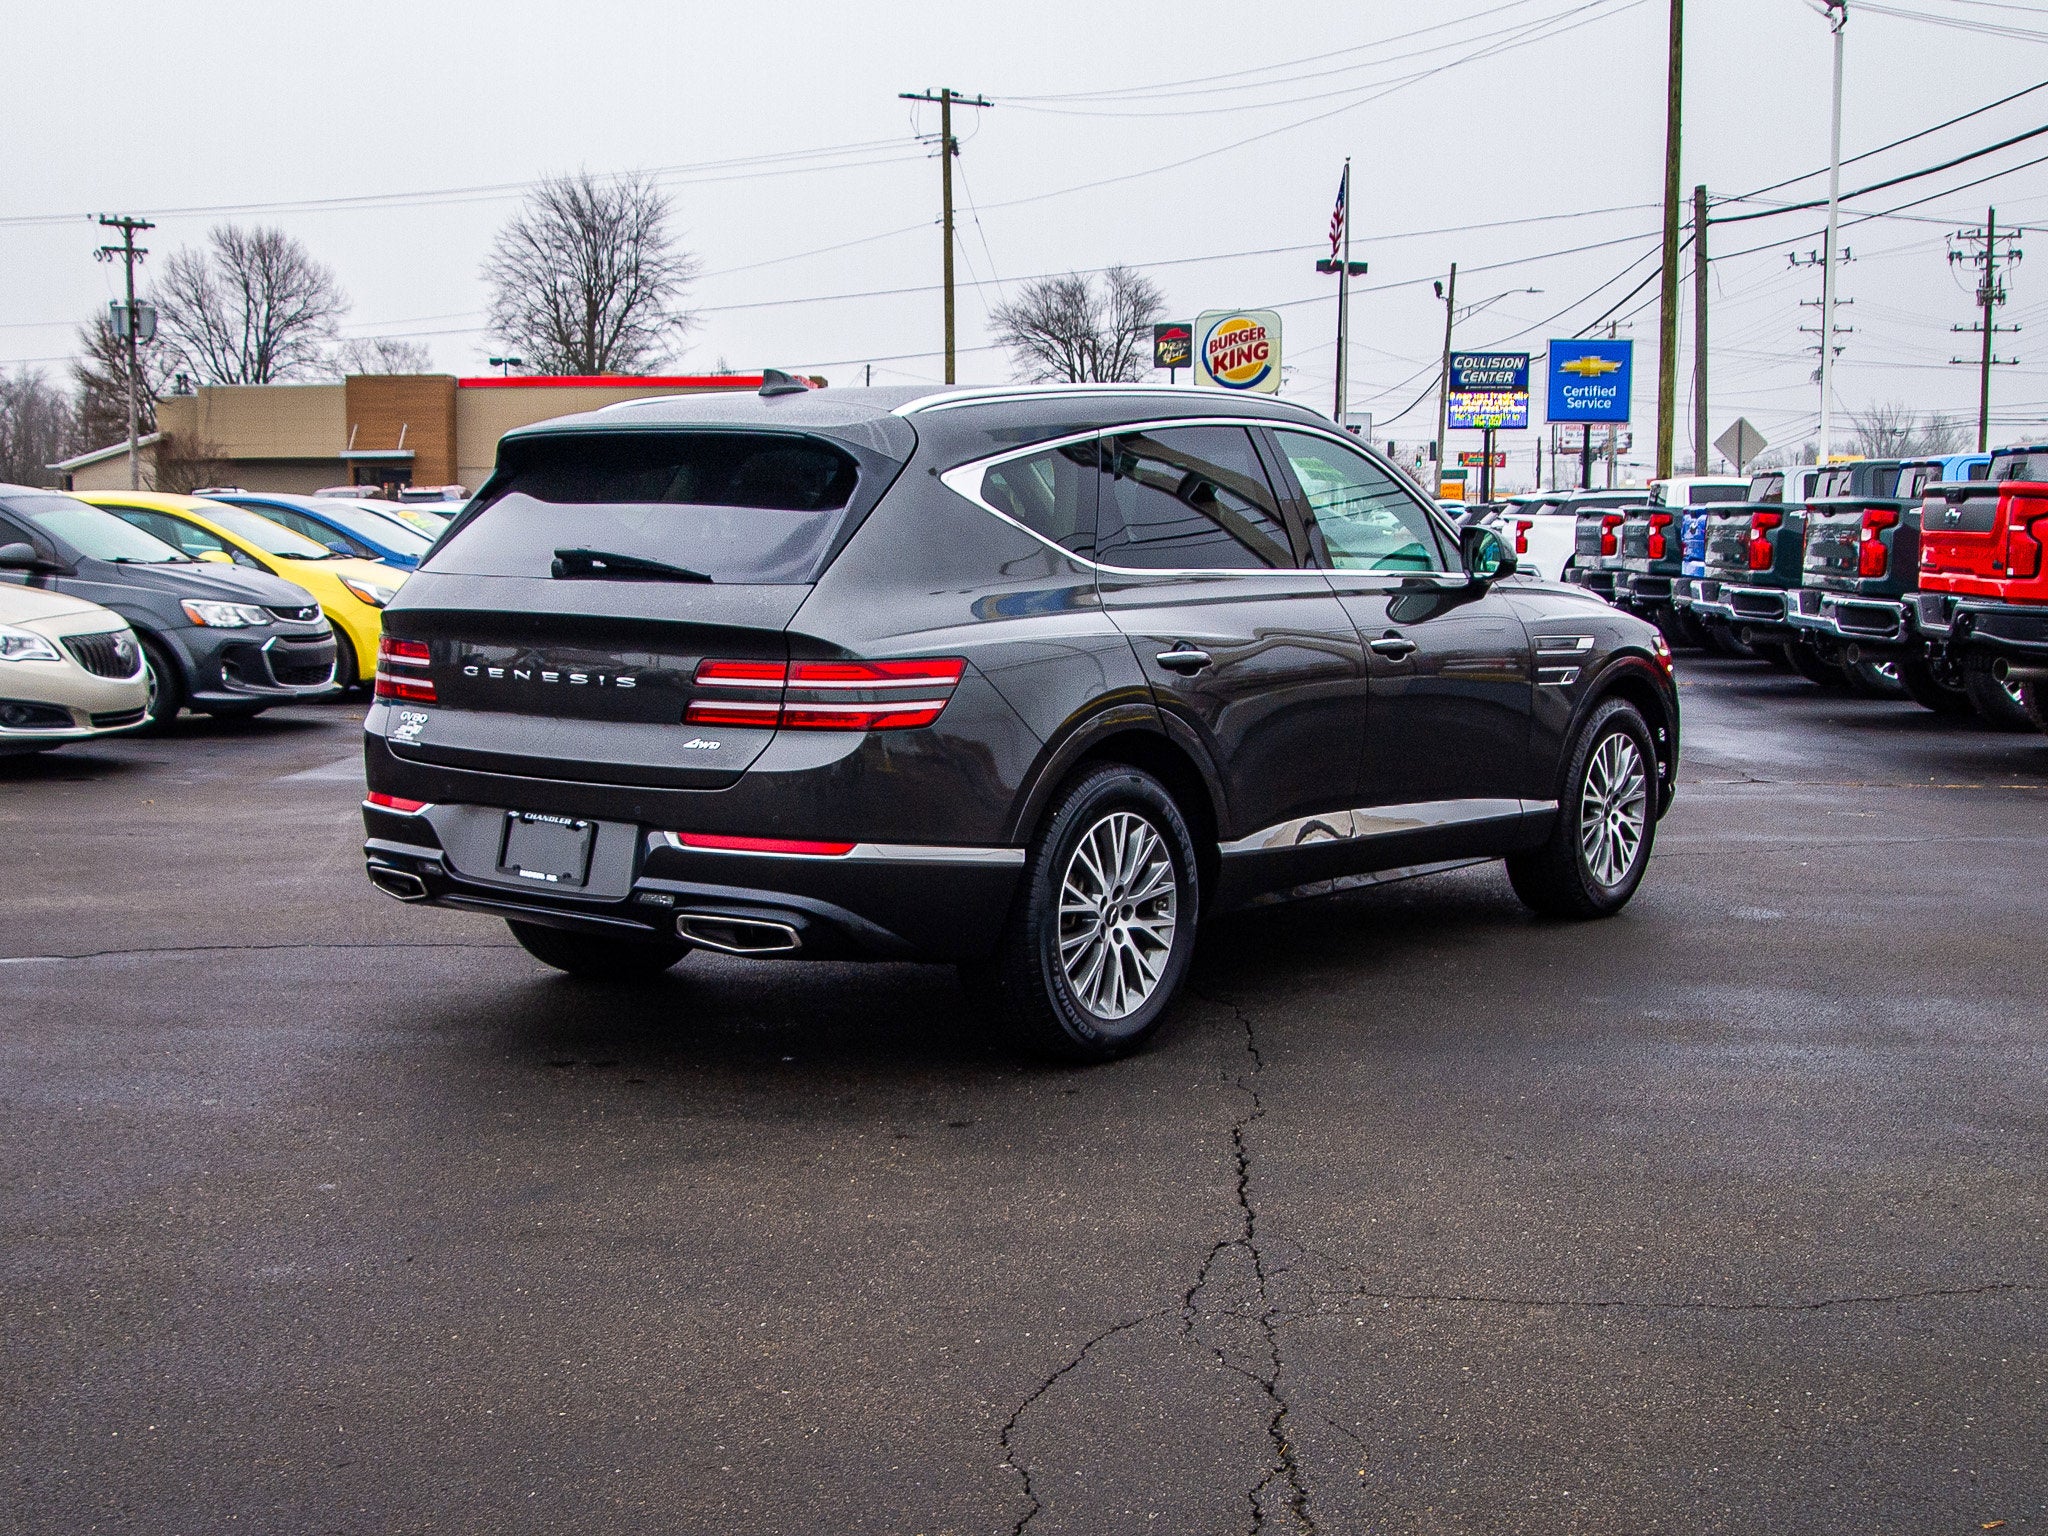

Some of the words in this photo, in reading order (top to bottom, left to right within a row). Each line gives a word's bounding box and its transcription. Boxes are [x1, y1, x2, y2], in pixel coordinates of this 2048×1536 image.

[1209, 327, 1266, 354] BURGER
[1212, 341, 1269, 376] KING
[1453, 356, 1526, 370] COLLISION
[1461, 370, 1514, 384] CENTER
[1563, 385, 1616, 397] Certified
[1567, 397, 1612, 409] Service
[463, 665, 637, 688] GENESIS
[400, 711, 428, 724] GV80
[524, 812, 572, 826] CHANDLER
[1052, 975, 1097, 1040] ROADIAN
